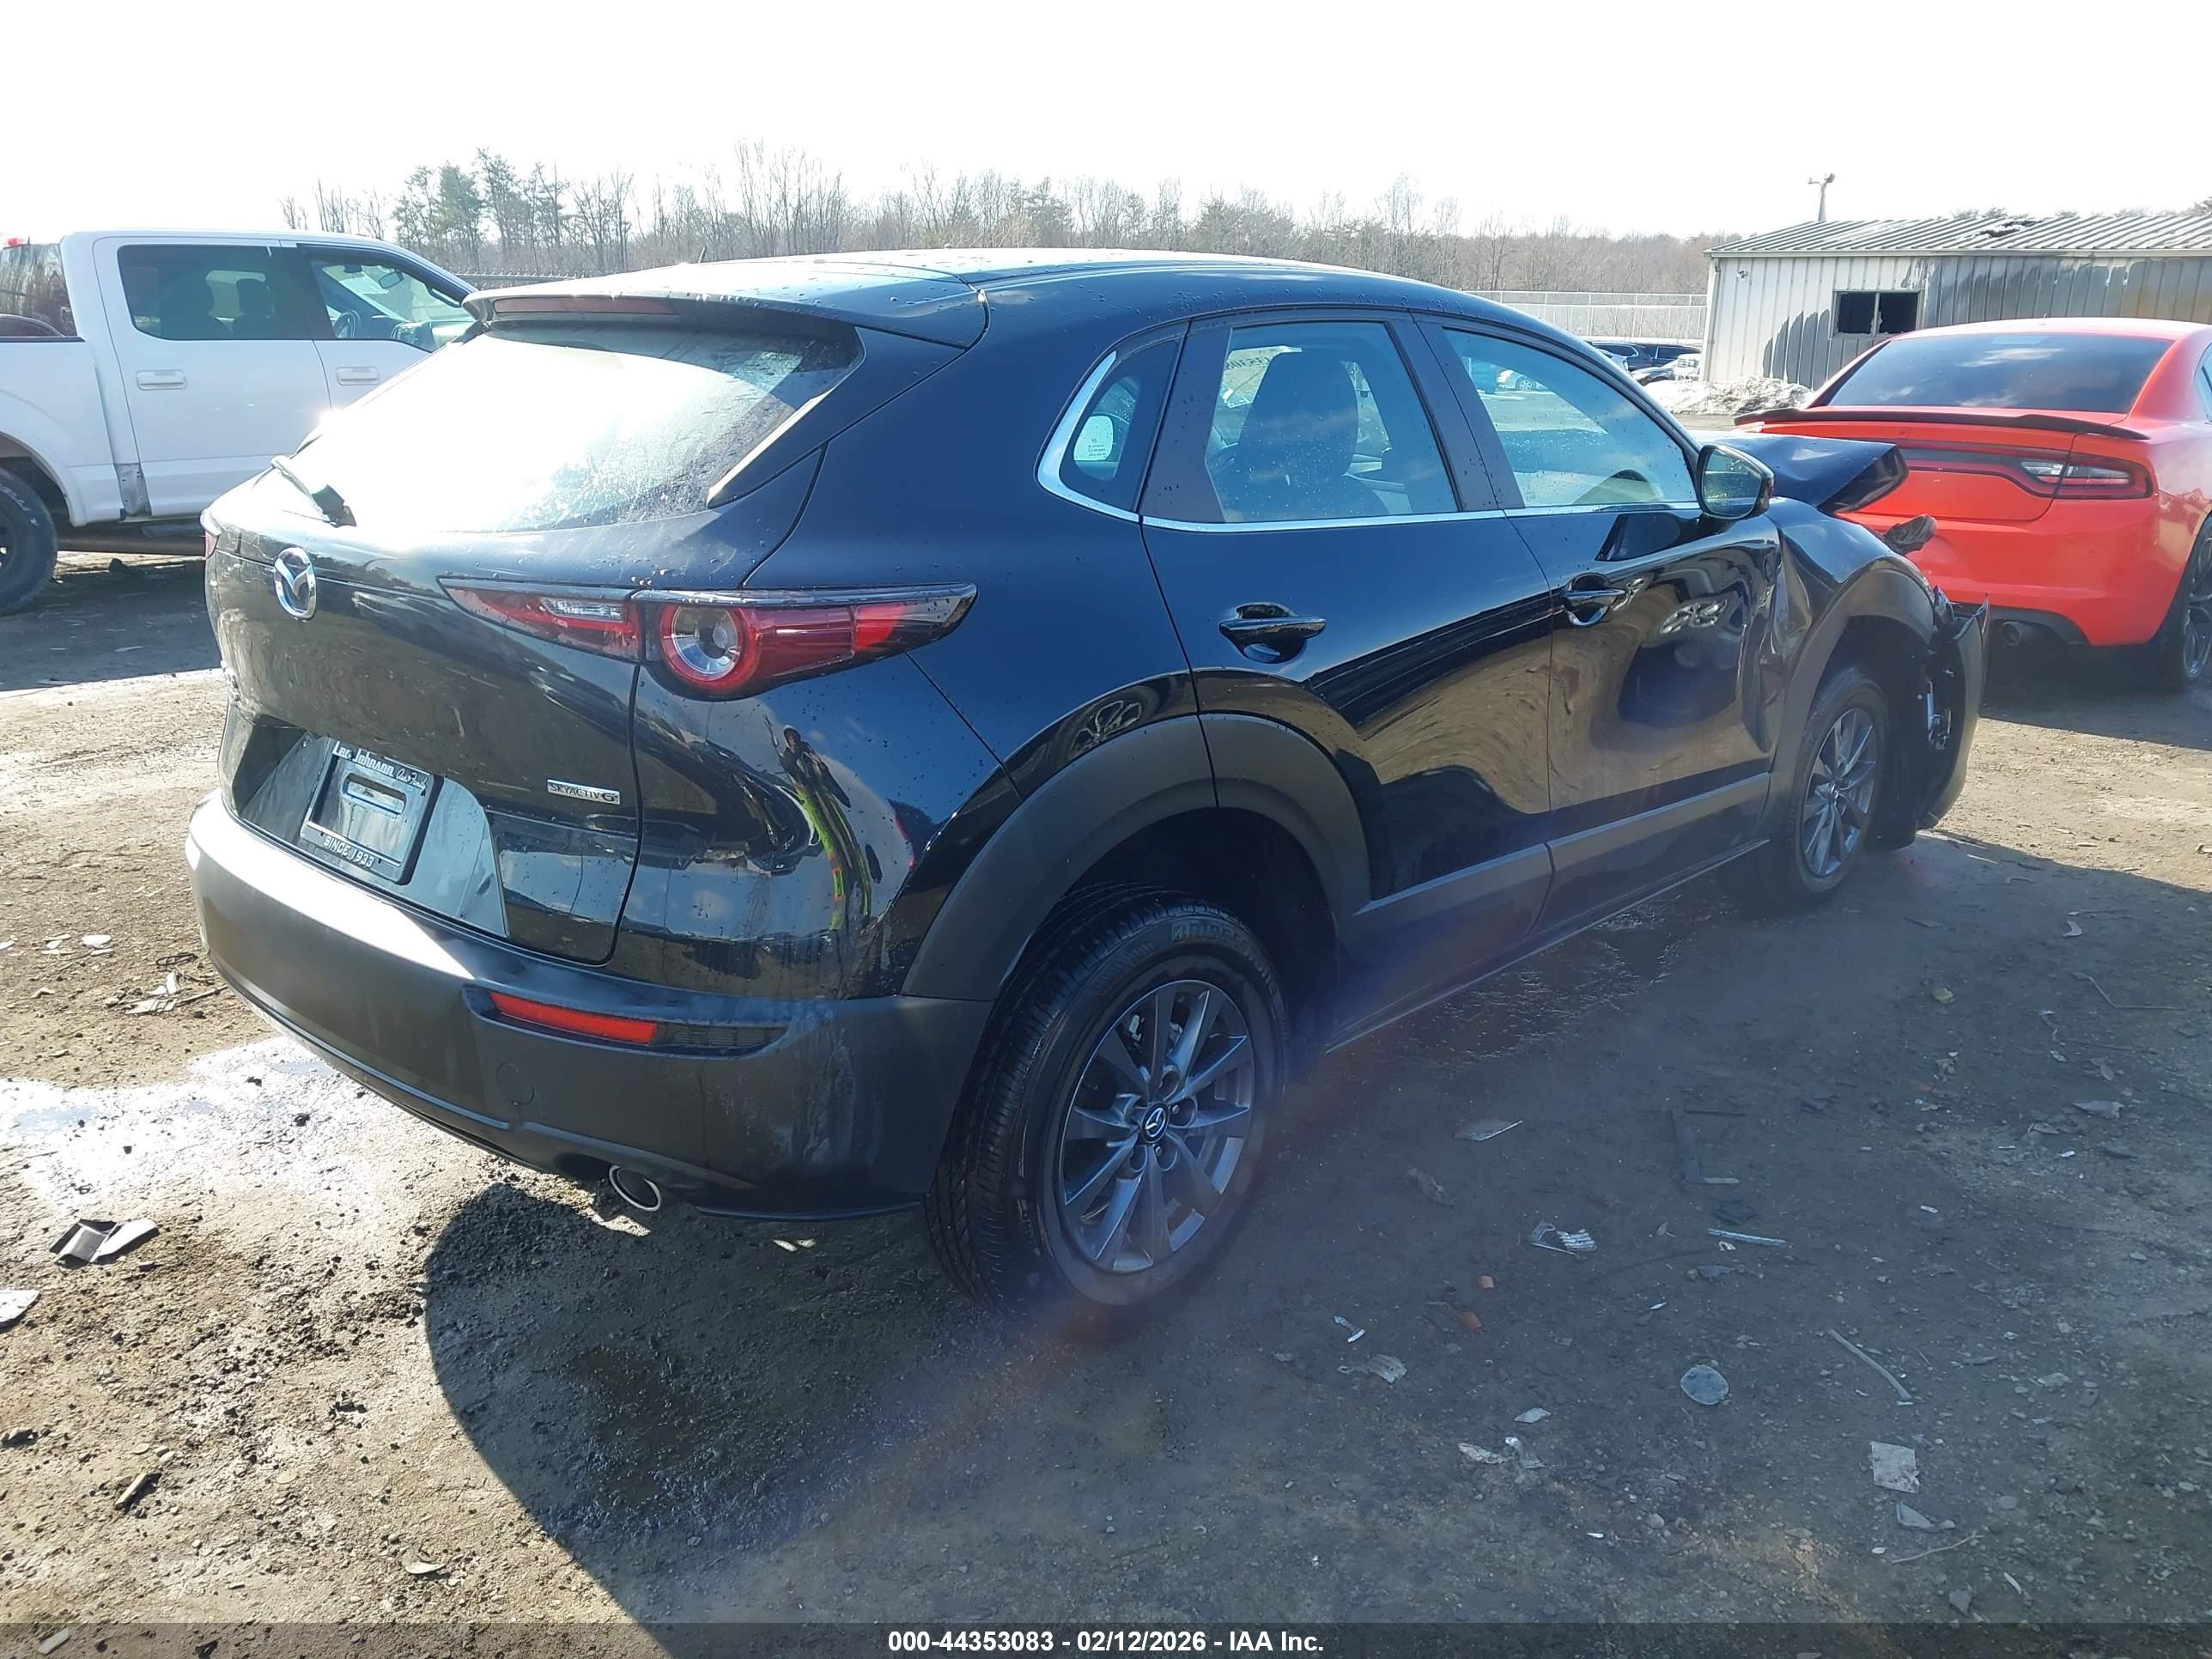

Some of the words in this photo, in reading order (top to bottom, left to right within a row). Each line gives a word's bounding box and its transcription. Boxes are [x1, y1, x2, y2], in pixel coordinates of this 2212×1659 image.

[352, 748, 396, 778] Johnson
[323, 836, 351, 860] SINCE
[350, 848, 375, 869] 1933
